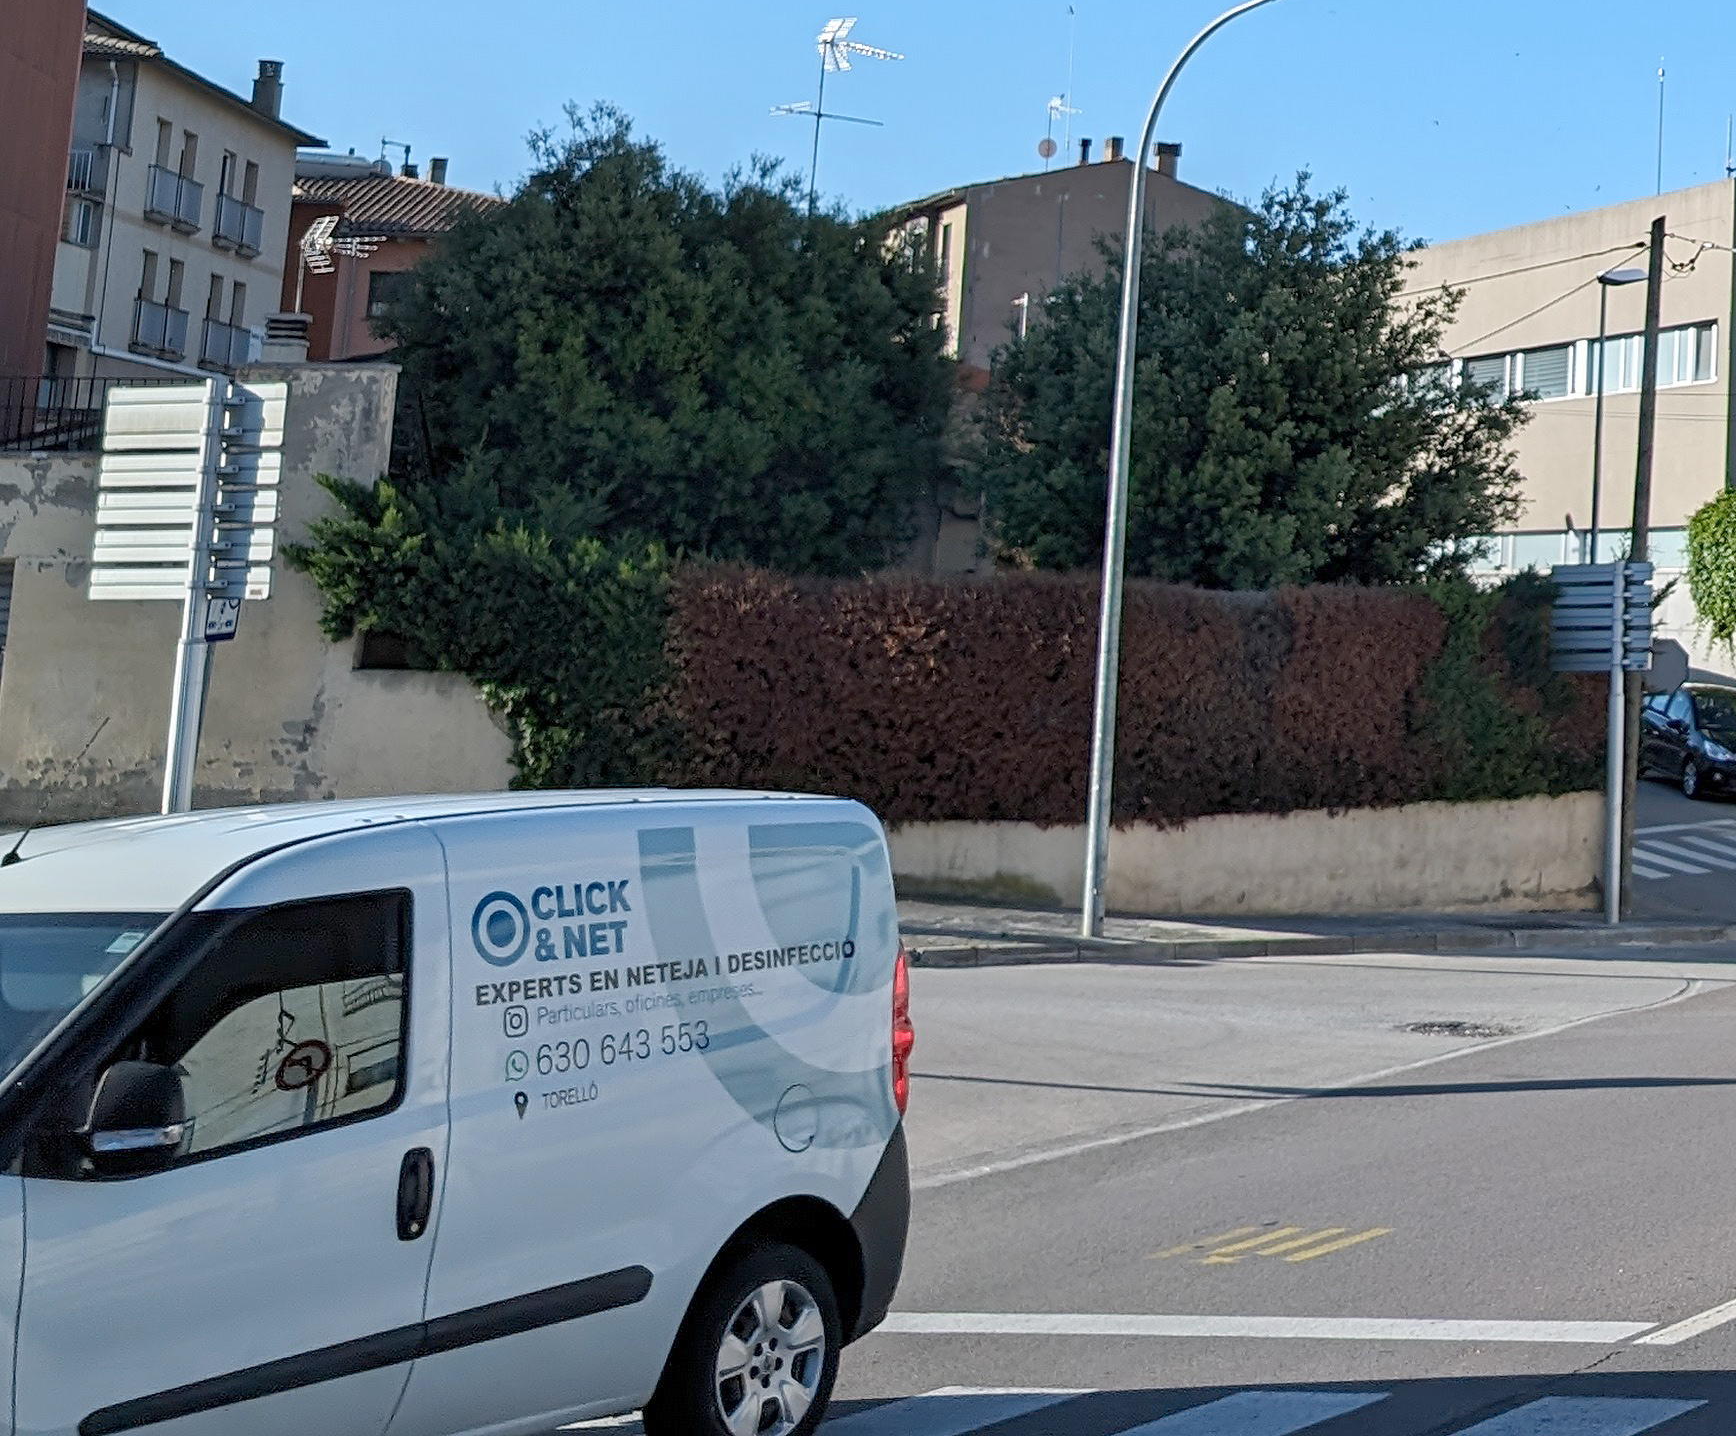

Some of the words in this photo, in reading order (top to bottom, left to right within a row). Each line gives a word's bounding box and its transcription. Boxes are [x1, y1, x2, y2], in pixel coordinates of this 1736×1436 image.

[531, 879, 632, 921] CLICK
[534, 927, 559, 962] &
[563, 920, 628, 959] NET
[475, 974, 583, 1006] EXPERTS
[589, 968, 619, 992] EN
[626, 957, 708, 988] NETEJA
[715, 956, 722, 976] I
[536, 1038, 590, 1076] 630
[600, 1028, 650, 1065] 643
[660, 1019, 711, 1055] 553
